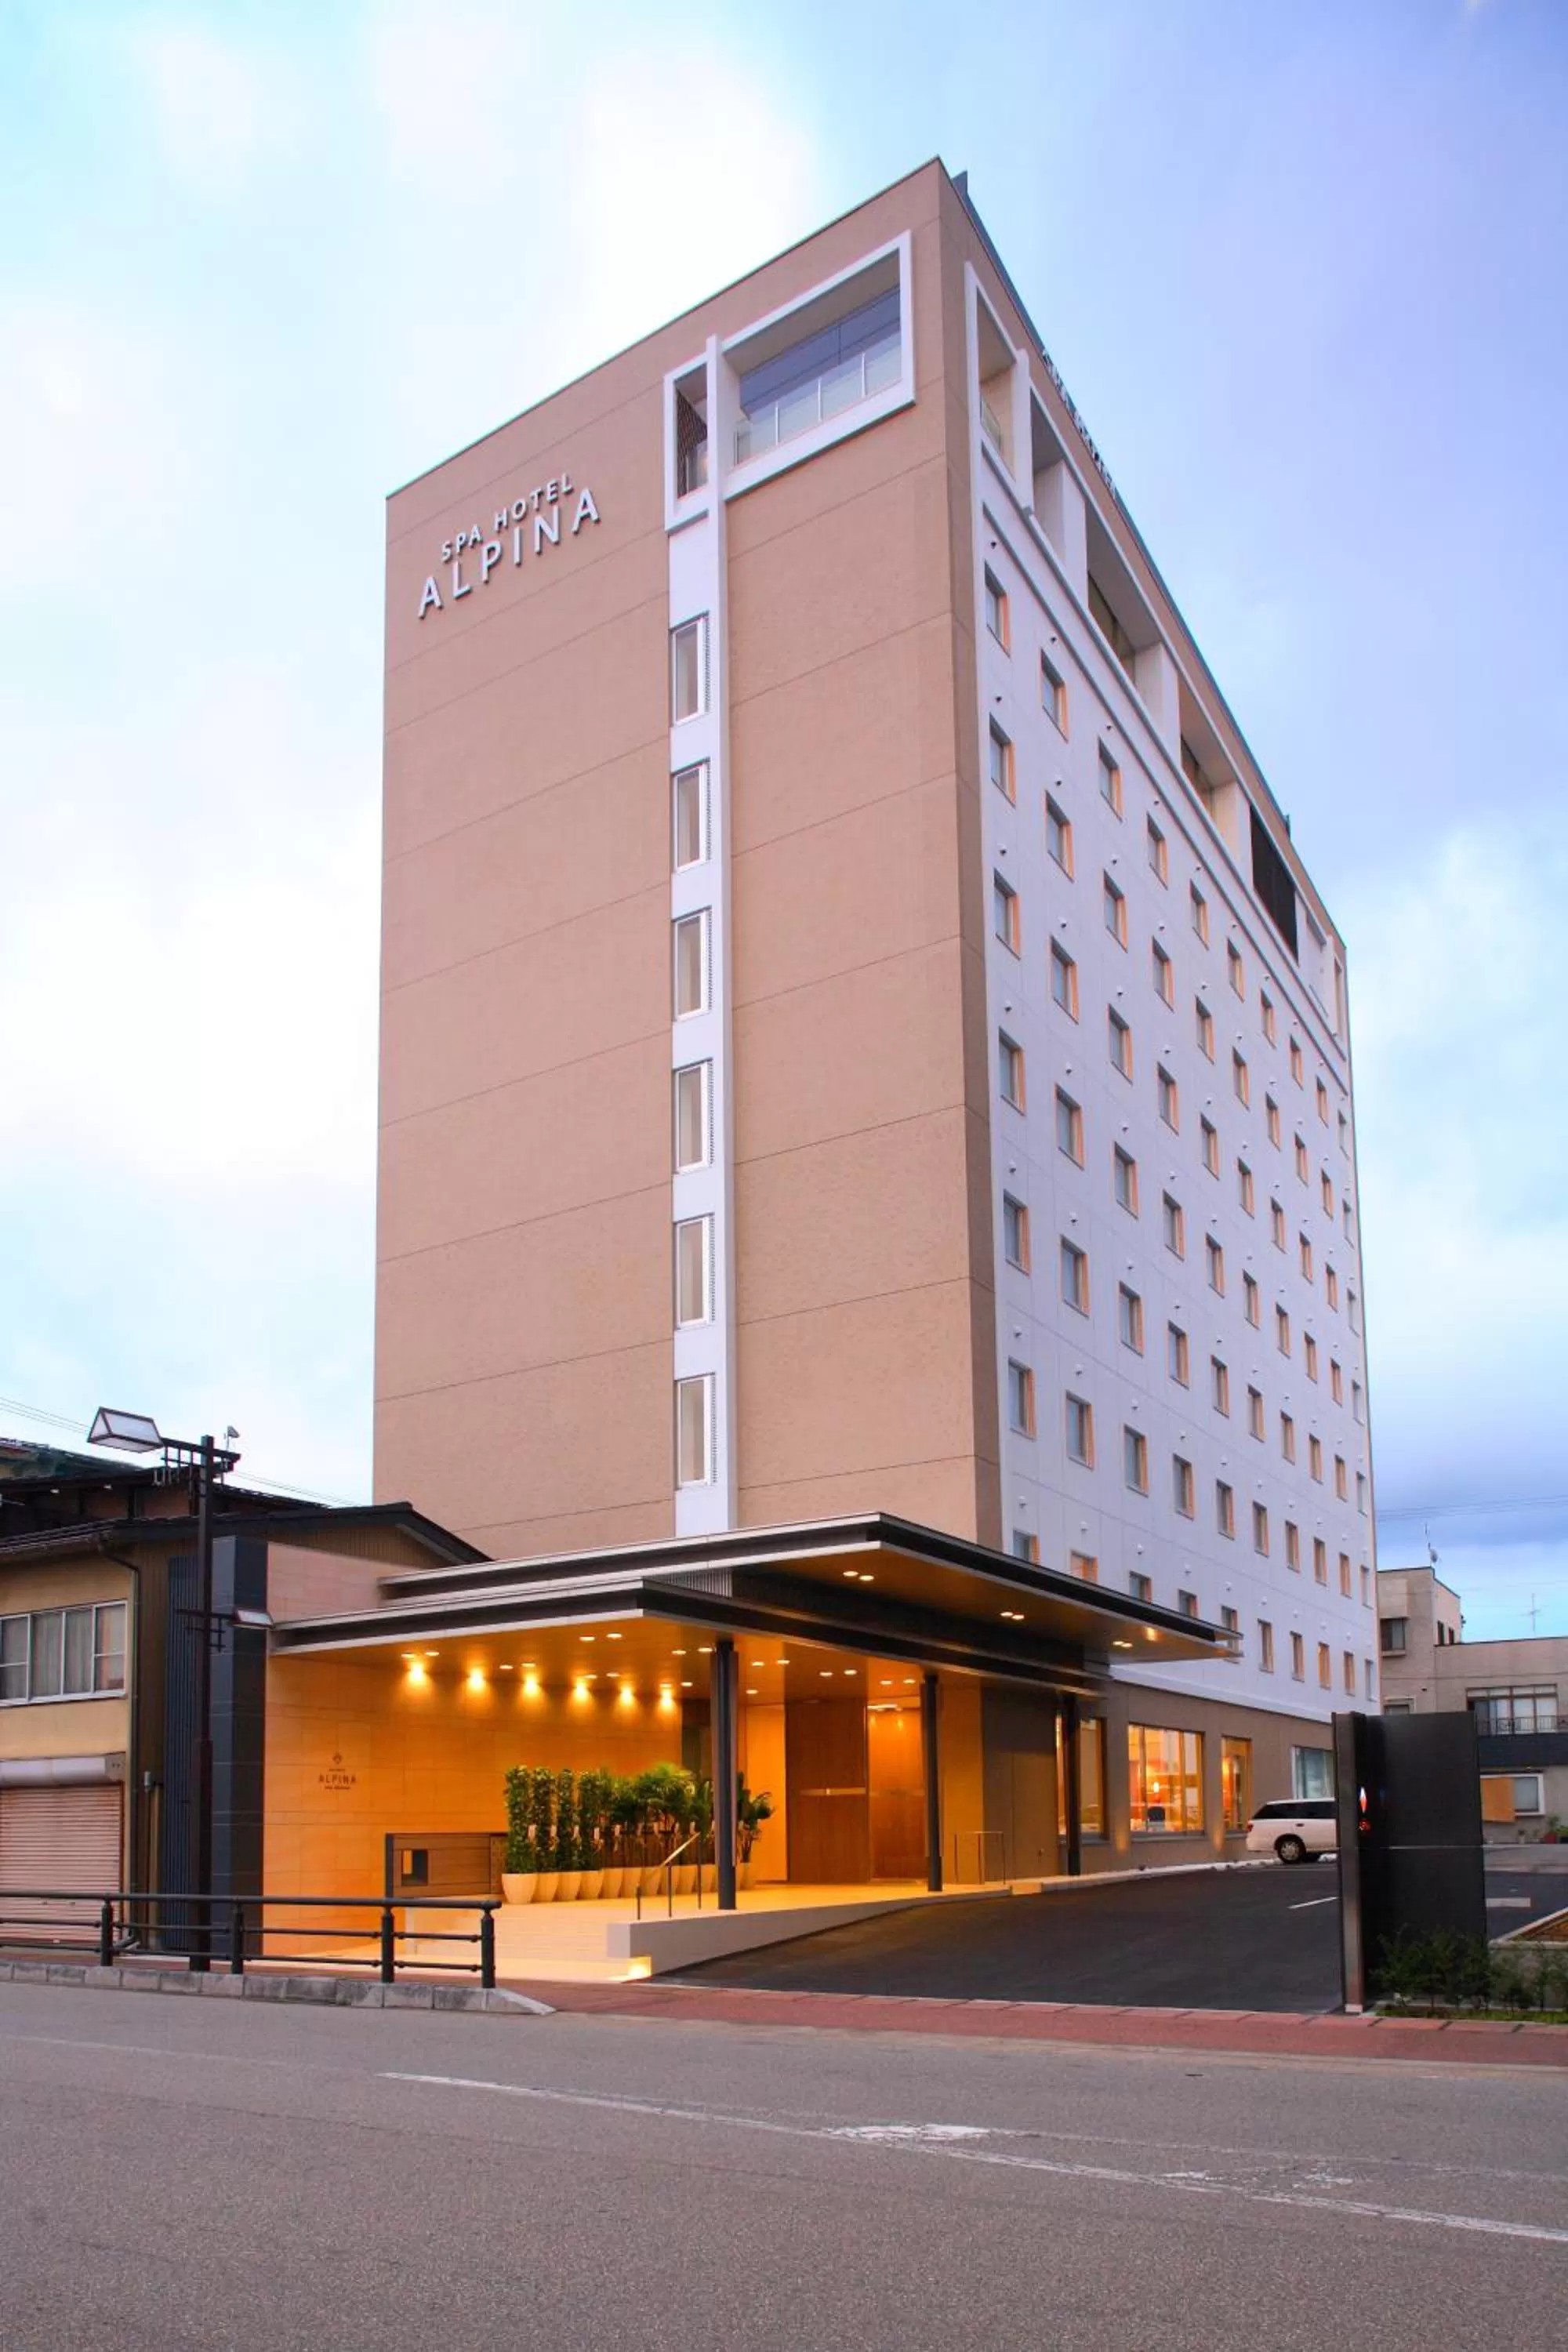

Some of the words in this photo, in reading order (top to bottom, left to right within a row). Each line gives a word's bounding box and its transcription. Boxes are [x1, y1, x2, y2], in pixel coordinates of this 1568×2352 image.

[418, 487, 601, 619] ALPINA
[441, 524, 483, 562] SPA
[494, 473, 573, 532] HOTEL
[318, 1773, 356, 1784] ALPINA
